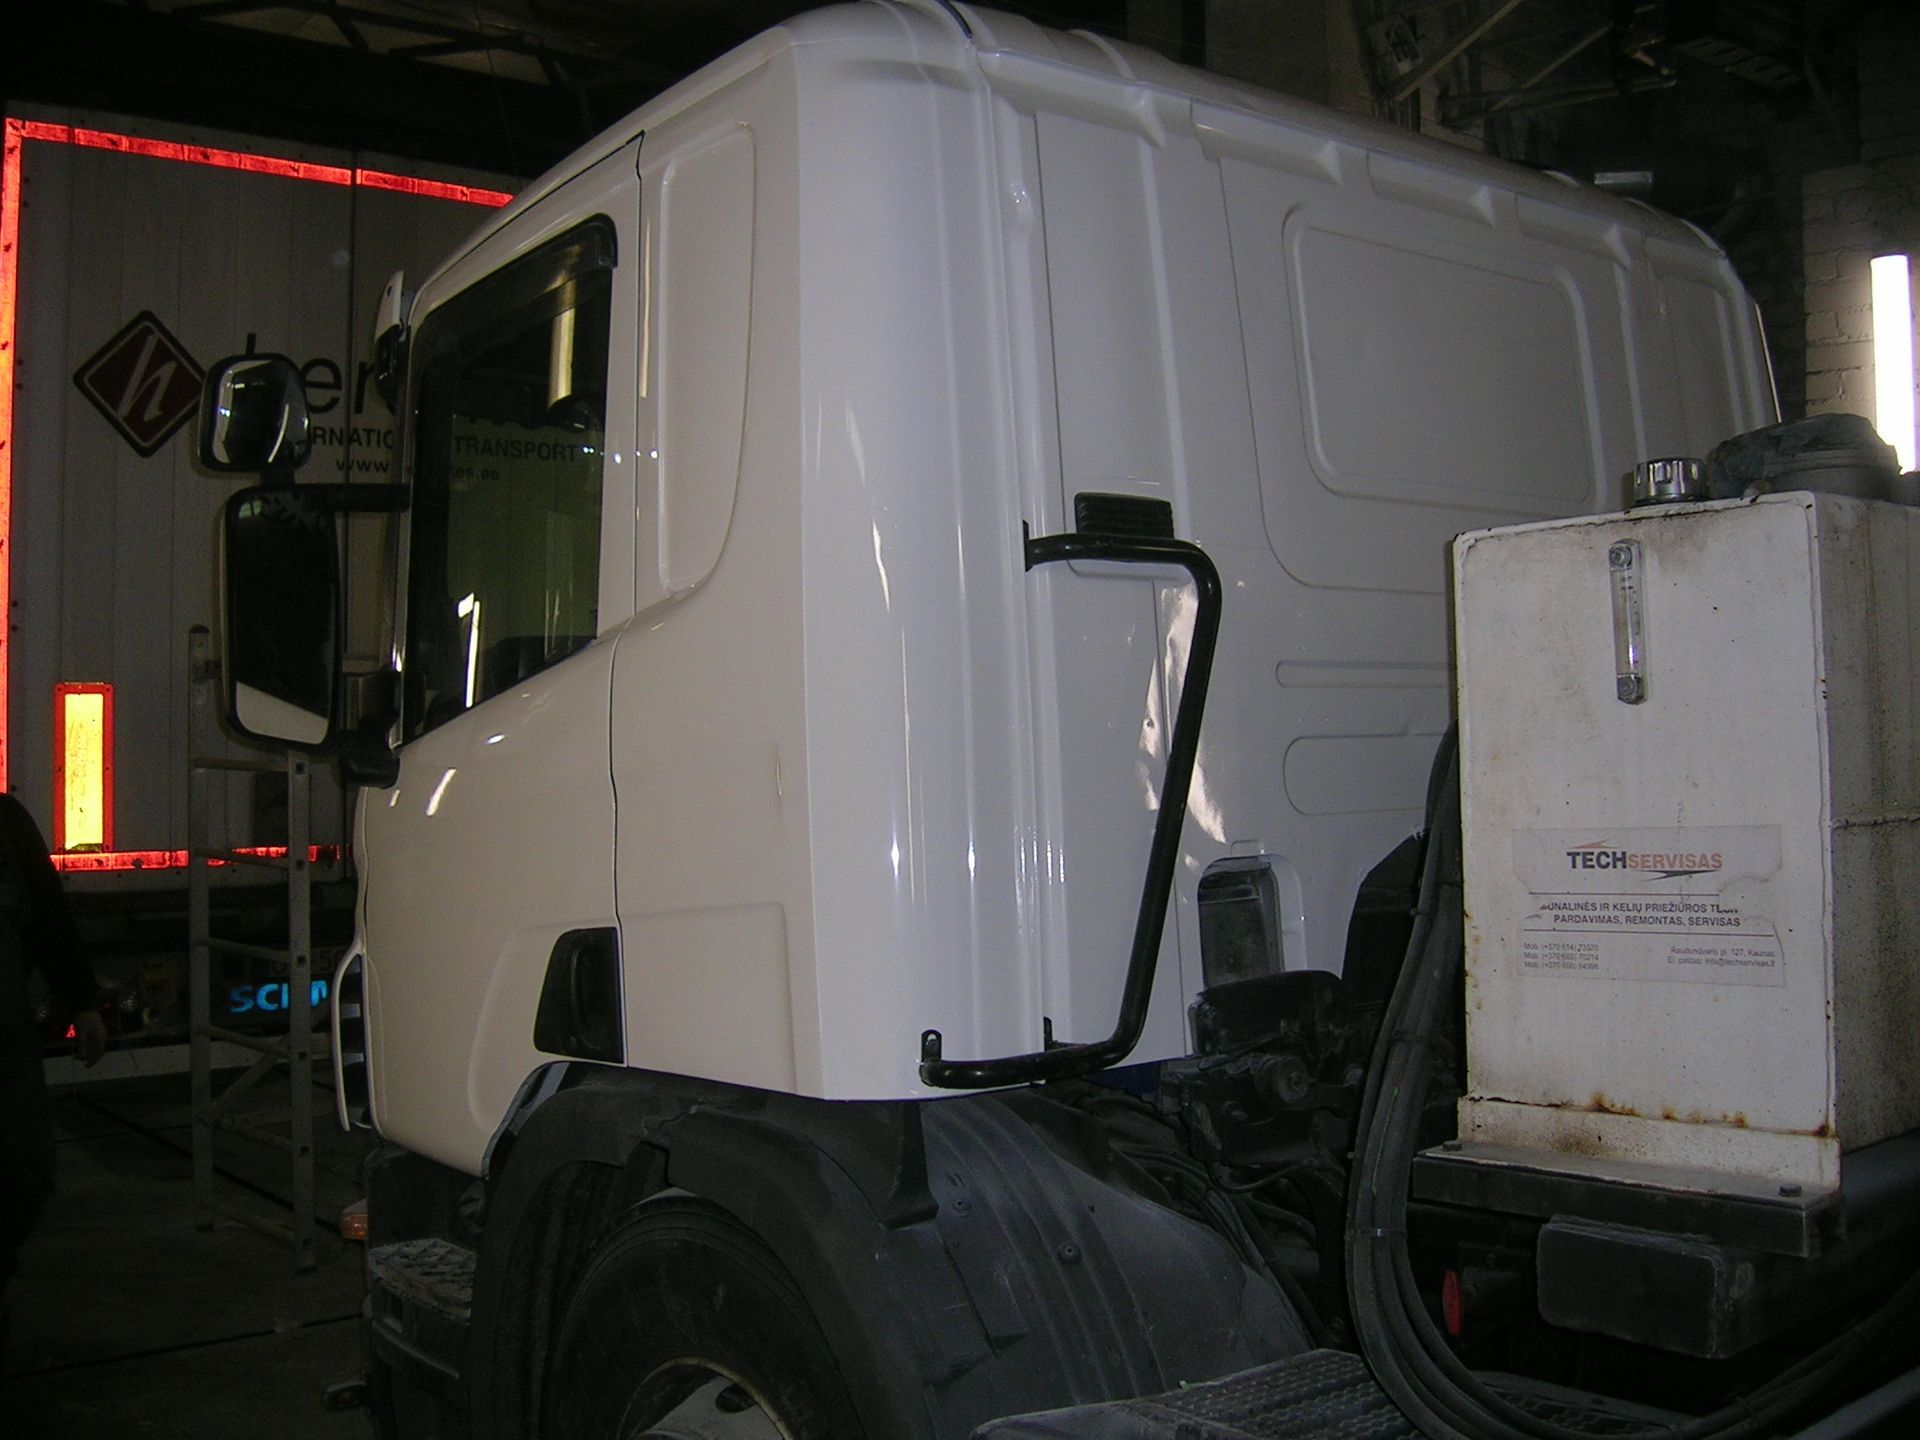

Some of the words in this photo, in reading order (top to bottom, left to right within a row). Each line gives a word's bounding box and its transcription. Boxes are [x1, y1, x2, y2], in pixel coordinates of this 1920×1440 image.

[453, 436, 577, 461] TRANSPORT
[1566, 851, 1723, 869] TECHSERVISAS
[1600, 903, 1610, 911] IR
[1553, 914, 1623, 925] PARDAVIMAS,
[1625, 915, 1686, 926] REMONTAS,
[1688, 917, 1741, 927] SERVISAS
